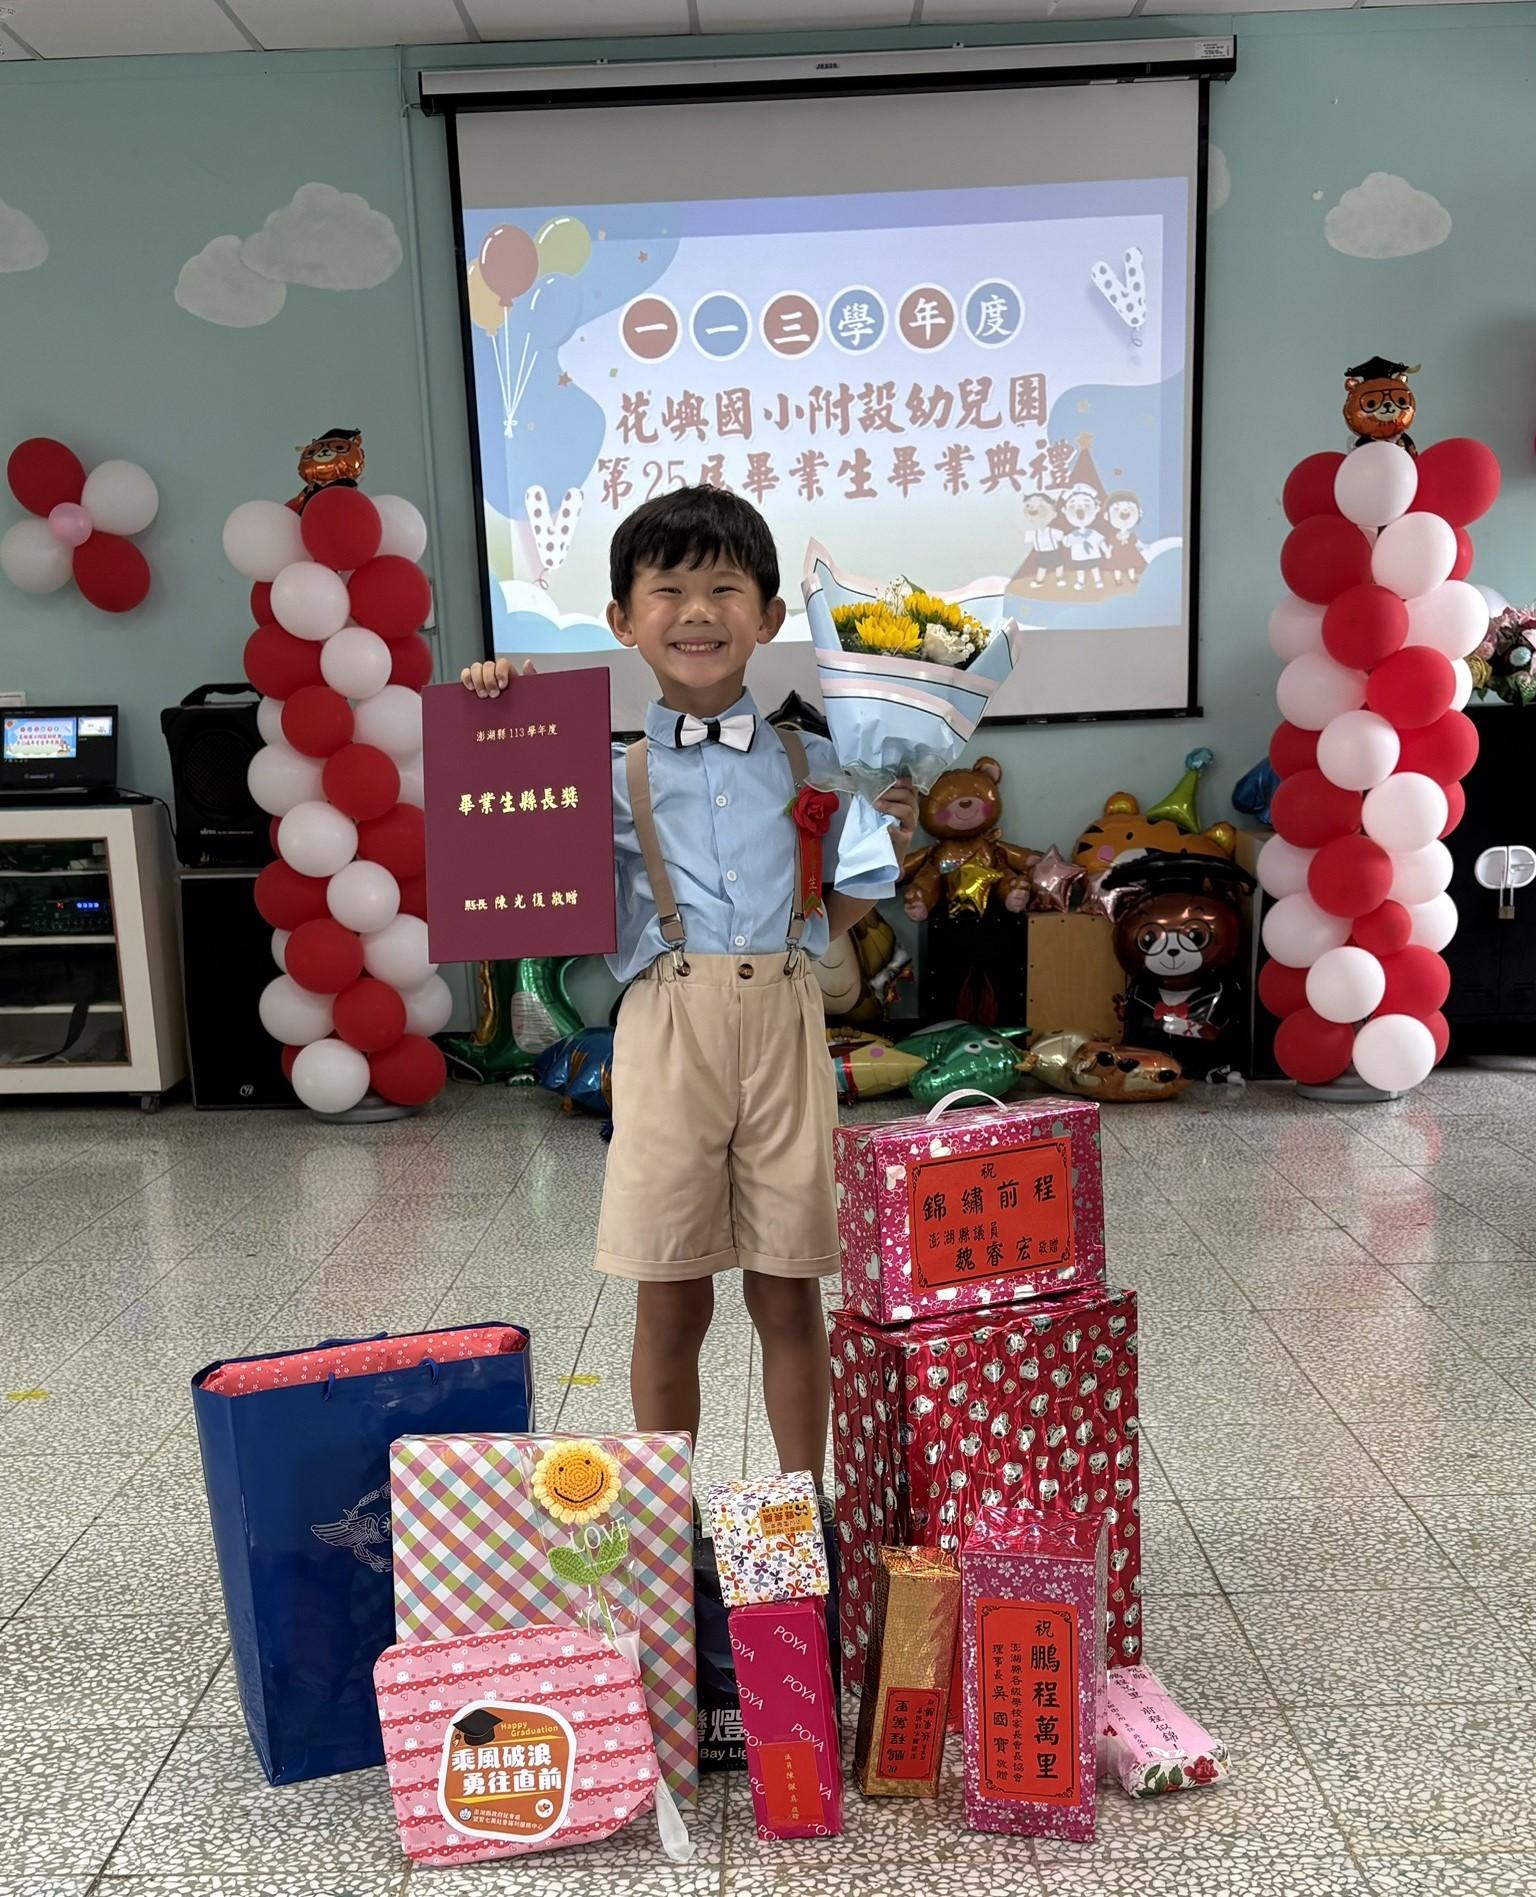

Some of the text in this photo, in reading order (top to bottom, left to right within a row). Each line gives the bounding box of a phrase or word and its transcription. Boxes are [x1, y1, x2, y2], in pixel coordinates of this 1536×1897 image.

[633, 295, 1010, 347] 一一三學年度
[615, 372, 1048, 445] 花嶼國小附設幼兒園
[980, 1162, 997, 1179] 祝
[922, 1173, 1057, 1222] 錦繡前程
[928, 1222, 999, 1249] 澎湖縣議員
[567, 1516, 629, 1554] LOVE
[773, 1625, 808, 1655] POYA
[782, 1674, 817, 1705] POYA
[500, 1721, 528, 1731] Happy
[511, 1725, 559, 1737] Graduation
[451, 1743, 552, 1771] 乘風破浪
[700, 1747, 748, 1761] Bay Lig
[463, 1767, 562, 1796] 勇往直前
